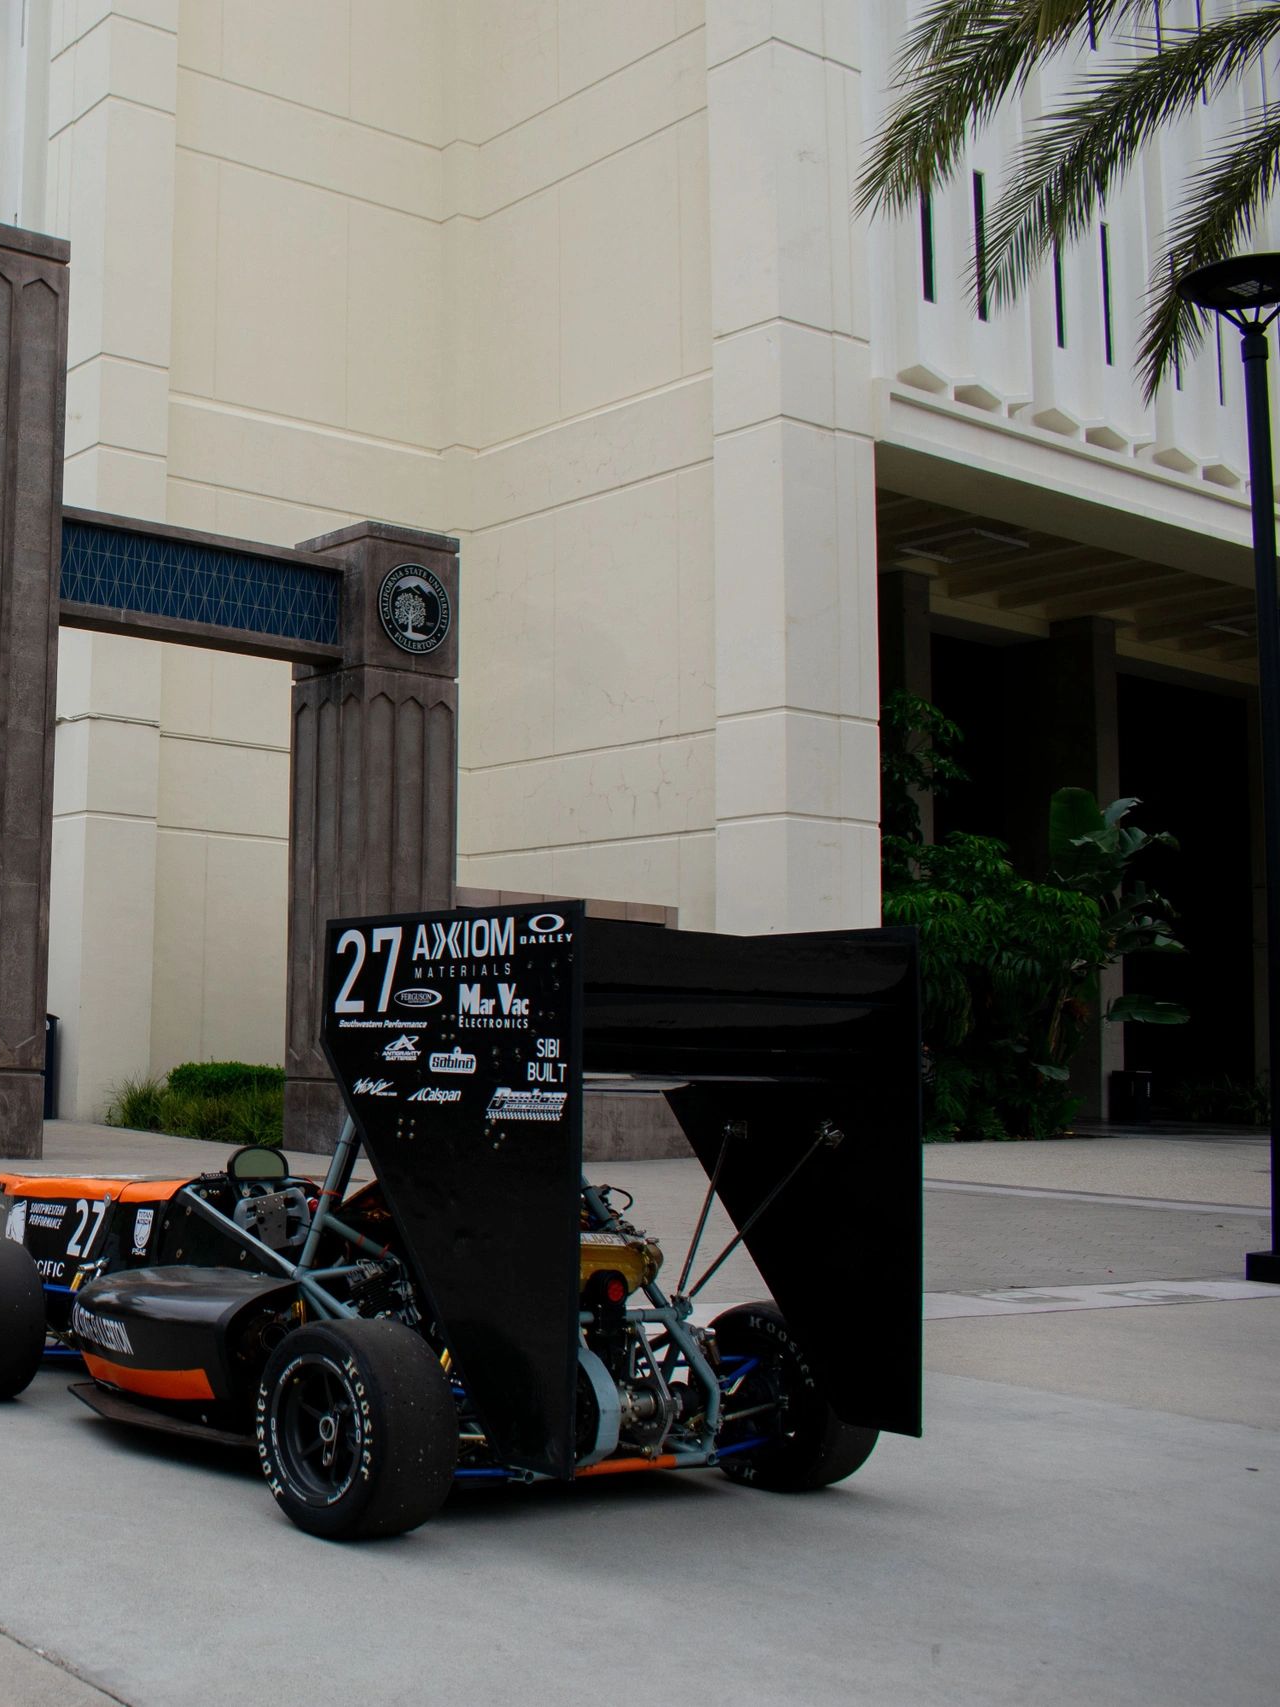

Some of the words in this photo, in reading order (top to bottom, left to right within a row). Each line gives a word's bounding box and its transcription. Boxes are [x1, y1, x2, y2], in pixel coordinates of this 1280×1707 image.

[383, 570, 404, 620] CALIFORNIA
[405, 567, 427, 579] STATE
[428, 576, 448, 631] UNIVERSITY
[394, 632, 438, 650] FULLERTON
[520, 933, 573, 945] OAKLEY
[335, 926, 403, 1013] 27
[414, 962, 511, 979] MATERIALS
[400, 992, 432, 1001] FERGUSON
[339, 1019, 383, 1028] Southwestern
[384, 1020, 428, 1029] Performance
[458, 1015, 530, 1029] ELECTRONICS
[527, 1062, 567, 1083] BUILT
[422, 1087, 462, 1104] Calspan
[66, 1198, 106, 1258] 27
